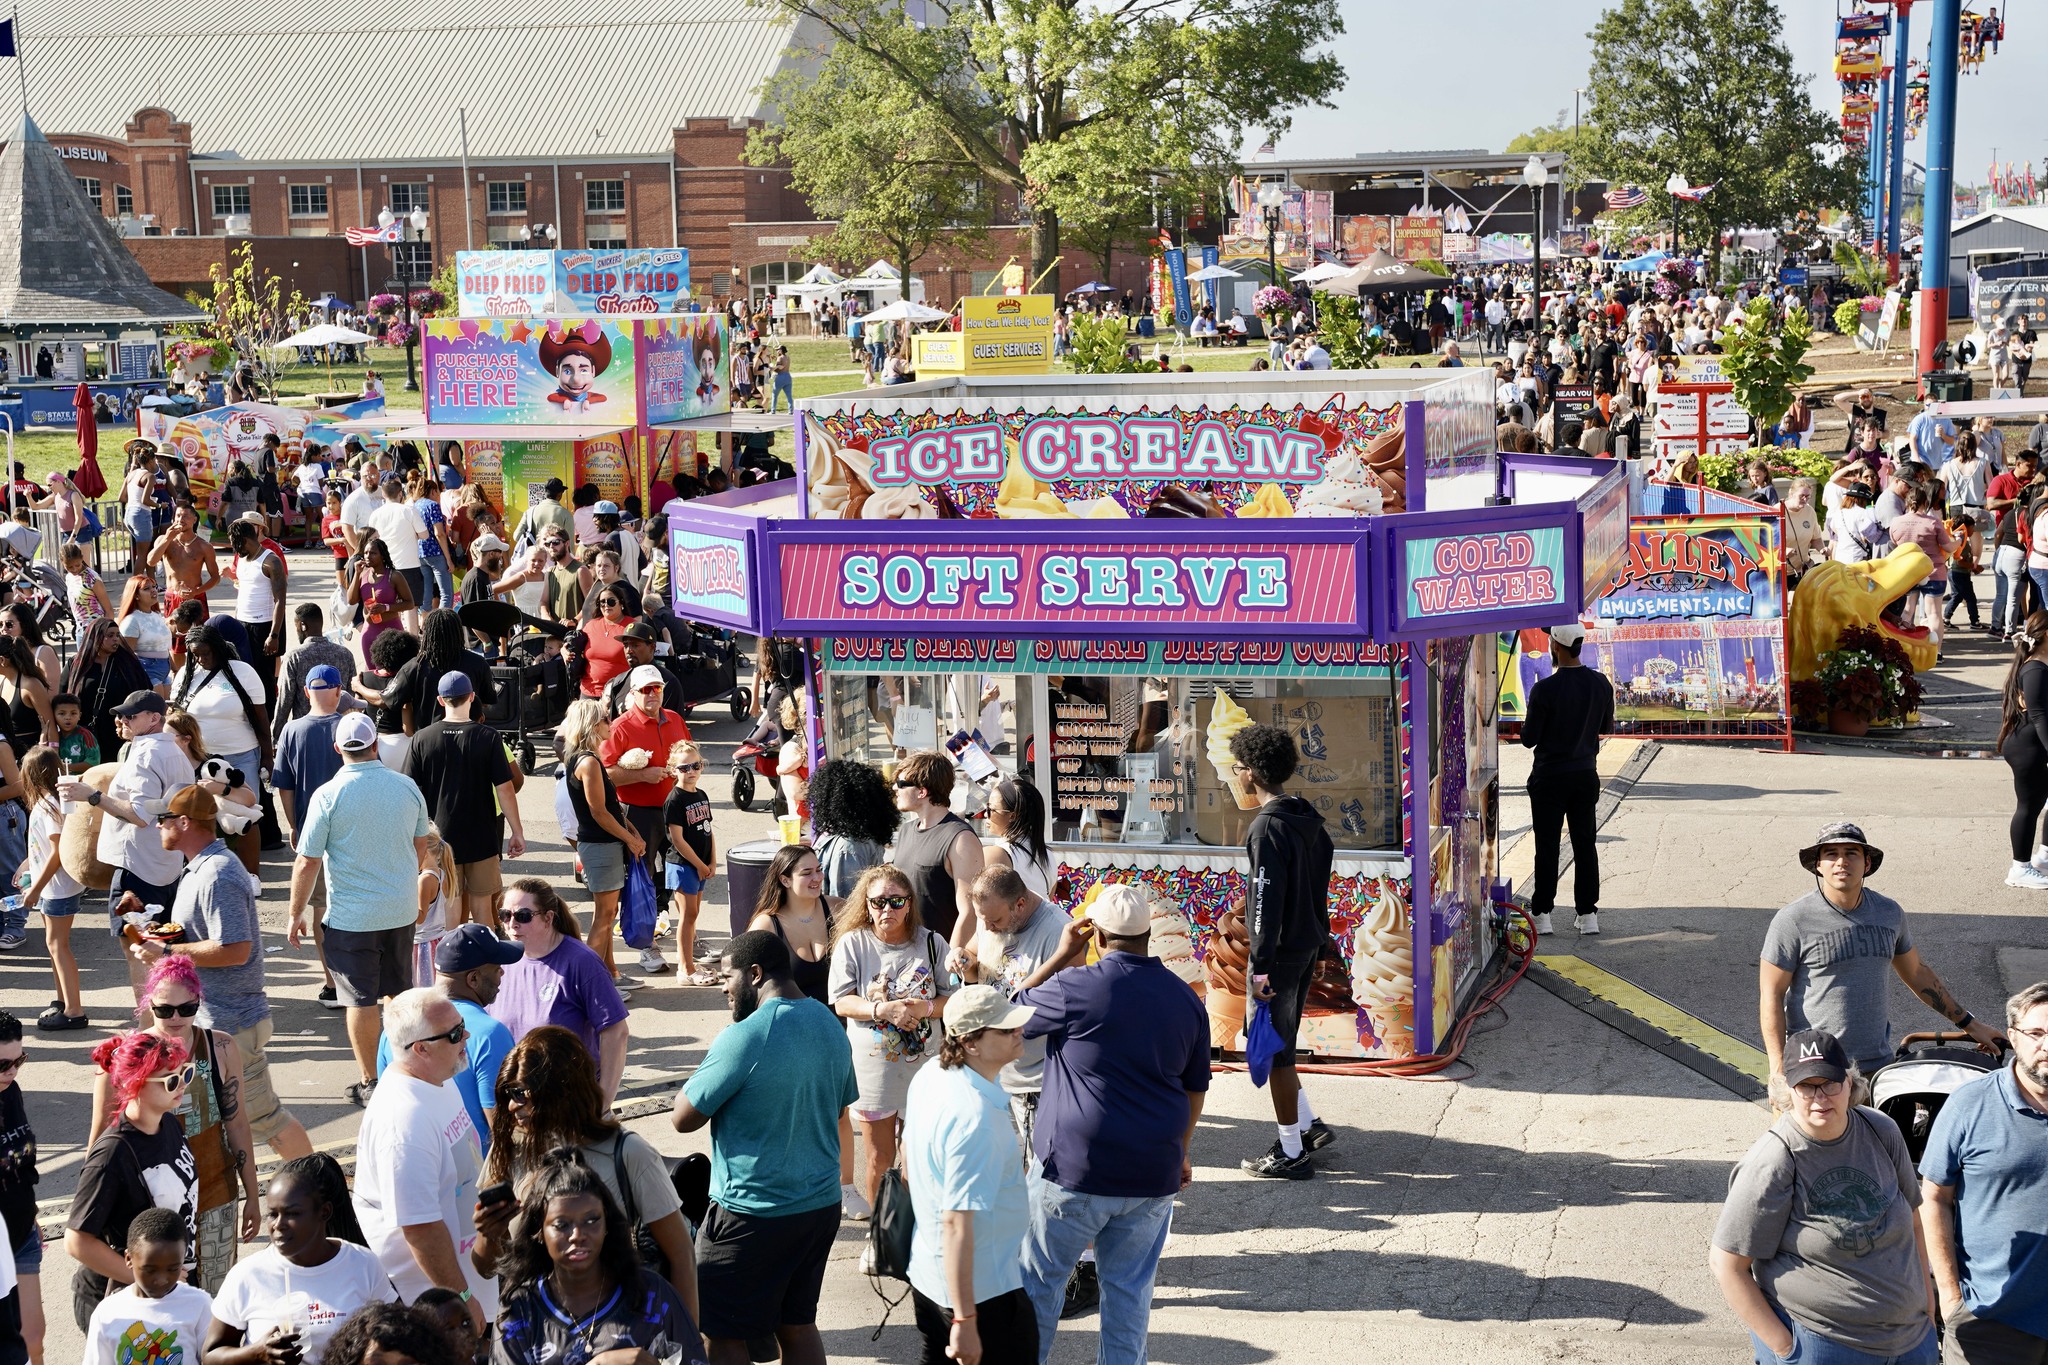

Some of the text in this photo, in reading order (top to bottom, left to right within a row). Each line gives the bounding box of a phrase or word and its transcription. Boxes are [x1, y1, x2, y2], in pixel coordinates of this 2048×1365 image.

[53, 146, 108, 163] OLISEUM
[1410, 219, 1427, 227] GIANT
[760, 236, 808, 245] EAST ENTRANC
[1396, 228, 1442, 238] CHOPPED SIRLOIN
[563, 255, 593, 270] Twinkies
[597, 254, 622, 269] SNICKERS
[652, 252, 682, 266] OREO
[1373, 263, 1406, 276] nrg
[465, 275, 546, 294] DEEP FRIED
[567, 272, 679, 293] DEEP FRIED
[1152, 258, 1161, 310] SAUSAGE
[1171, 253, 1185, 308] INFORMATION
[1980, 285, 1999, 294] EXPO
[2003, 283, 2039, 293] CENTER
[486, 295, 531, 315] Treats
[597, 293, 658, 313] Treats
[1932, 291, 1939, 302] 3
[966, 315, 1050, 328] How Can We Help You?
[928, 342, 950, 351] GUEST
[973, 342, 1043, 359] GUEST SERVICES
[435, 353, 518, 367] PURCHASE
[648, 350, 684, 367] PURCHASE
[923, 353, 956, 362] SERVICES
[438, 368, 518, 381] & RELOAD
[649, 365, 684, 381] & RELOAD
[1691, 374, 1721, 382] STATE
[439, 382, 518, 406] HERE
[649, 379, 684, 406] HERE
[527, 444, 549, 452] LINE!
[583, 442, 625, 459] TALLEY'S
[876, 425, 1318, 480] ICE CREAM
[592, 462, 615, 470] money
[1436, 535, 1534, 575] COLD
[676, 547, 745, 597] SWIRL
[1599, 533, 1760, 599] ALLEY
[843, 554, 1290, 608] SOFT SERVE
[1415, 568, 1554, 612] WATER
[626, 623, 635, 633] P
[1613, 624, 1701, 640] AMUSEMENTS
[1714, 622, 1779, 637] Welcome
[834, 638, 908, 659] SOFT
[915, 638, 1016, 660] SERVE
[1036, 640, 1147, 661] SWIRL
[1164, 641, 1283, 662] DIPPED
[1055, 703, 1107, 719] VANILLA
[1056, 722, 1124, 737] CHOCOLATE
[1055, 740, 1087, 755] DOLE
[1089, 740, 1123, 755] WHIP
[1057, 758, 1082, 774] CUP
[1057, 777, 1102, 792] DIPPED
[1103, 777, 1136, 793] CONE
[1149, 778, 1174, 794] ADD
[1058, 795, 1119, 811] TOPPINGS
[1149, 796, 1175, 812] ADD
[1815, 926, 1855, 969] OHIO
[1800, 1041, 1822, 1058] M
